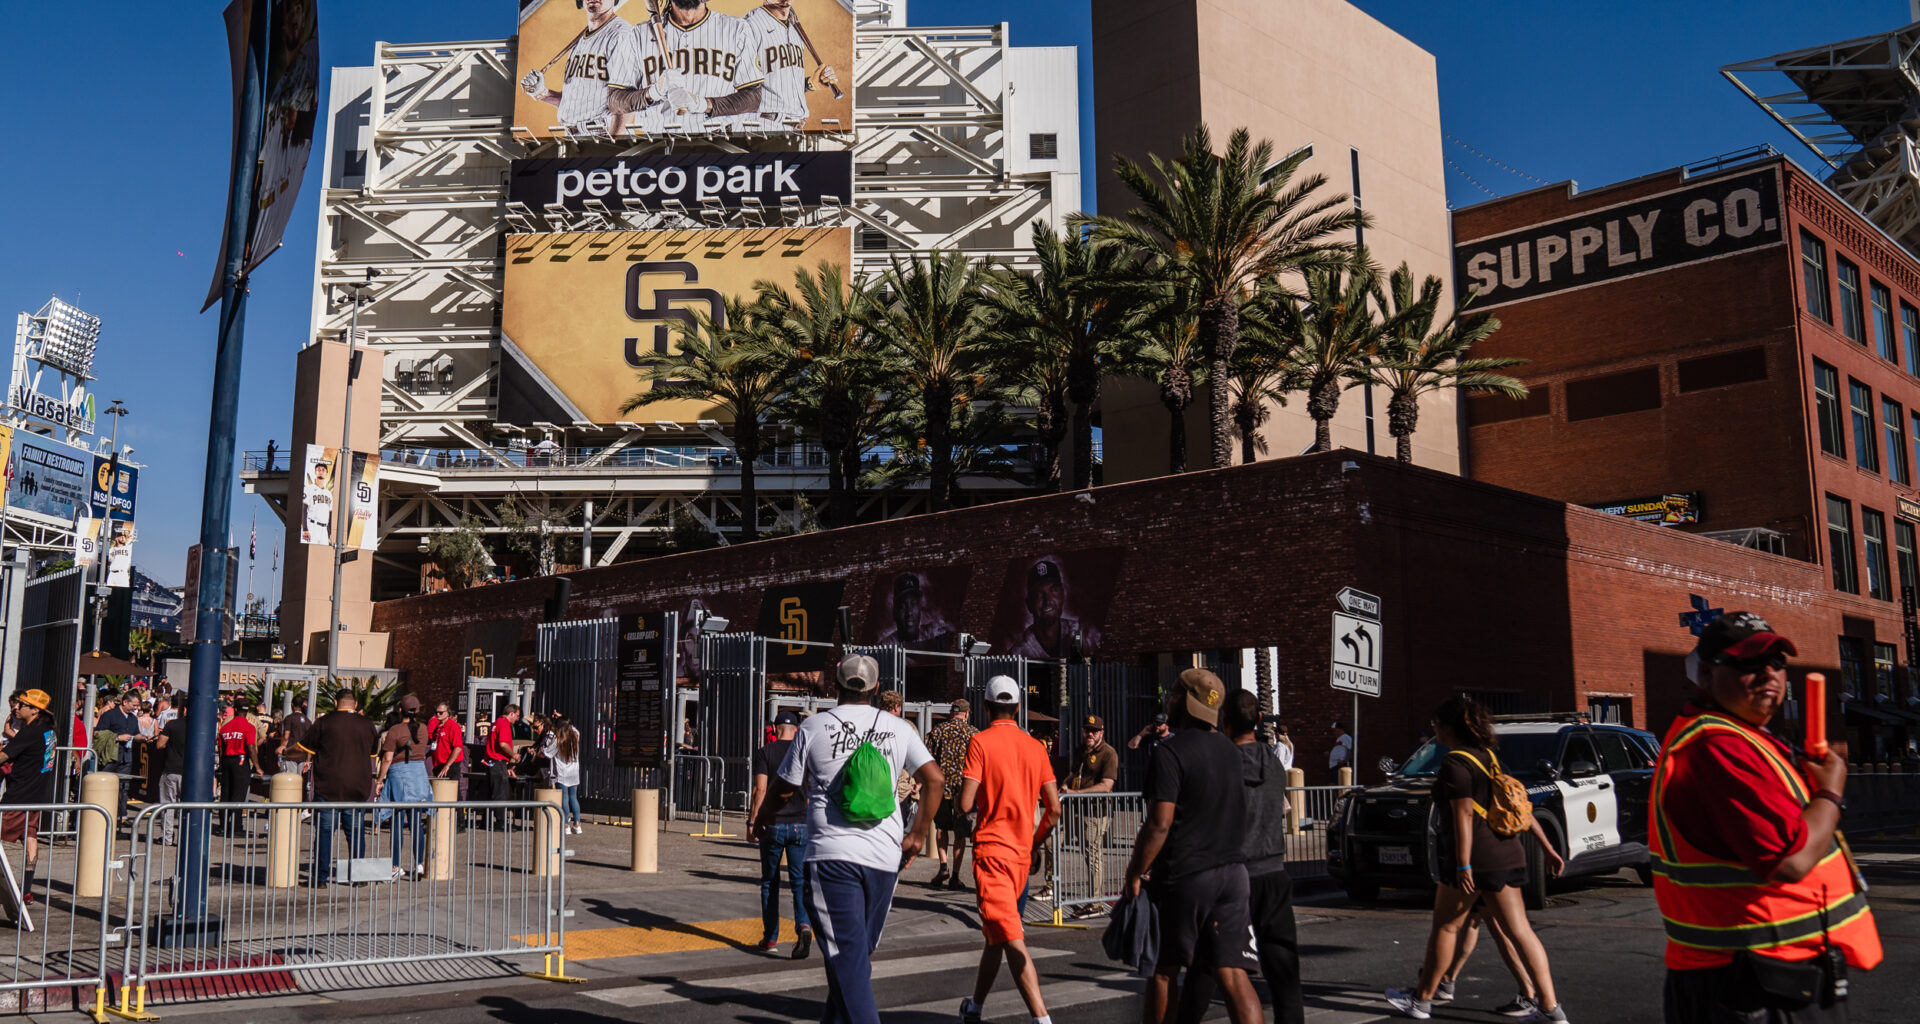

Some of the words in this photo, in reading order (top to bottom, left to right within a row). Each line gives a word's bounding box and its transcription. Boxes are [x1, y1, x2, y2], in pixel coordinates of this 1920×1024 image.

[565, 53, 609, 82] DRES
[556, 160, 687, 205] petco
[696, 160, 801, 202] park
[1467, 209, 1661, 297] SUPPLY
[1683, 187, 1777, 247] CO.
[19, 385, 73, 426] Viasat
[22, 445, 47, 464] FAMILY
[46, 453, 84, 475] RESTROOMS
[357, 481, 371, 503] SD
[1627, 501, 1669, 513] SUNDAY
[82, 538, 94, 553] SD
[1348, 596, 1362, 609] ONE
[1363, 600, 1376, 613] WAY
[779, 596, 808, 656] SD
[1334, 669, 1346, 680] NO
[1348, 670, 1357, 684] U
[1358, 674, 1378, 687] TURN
[830, 728, 896, 759] Heritage
